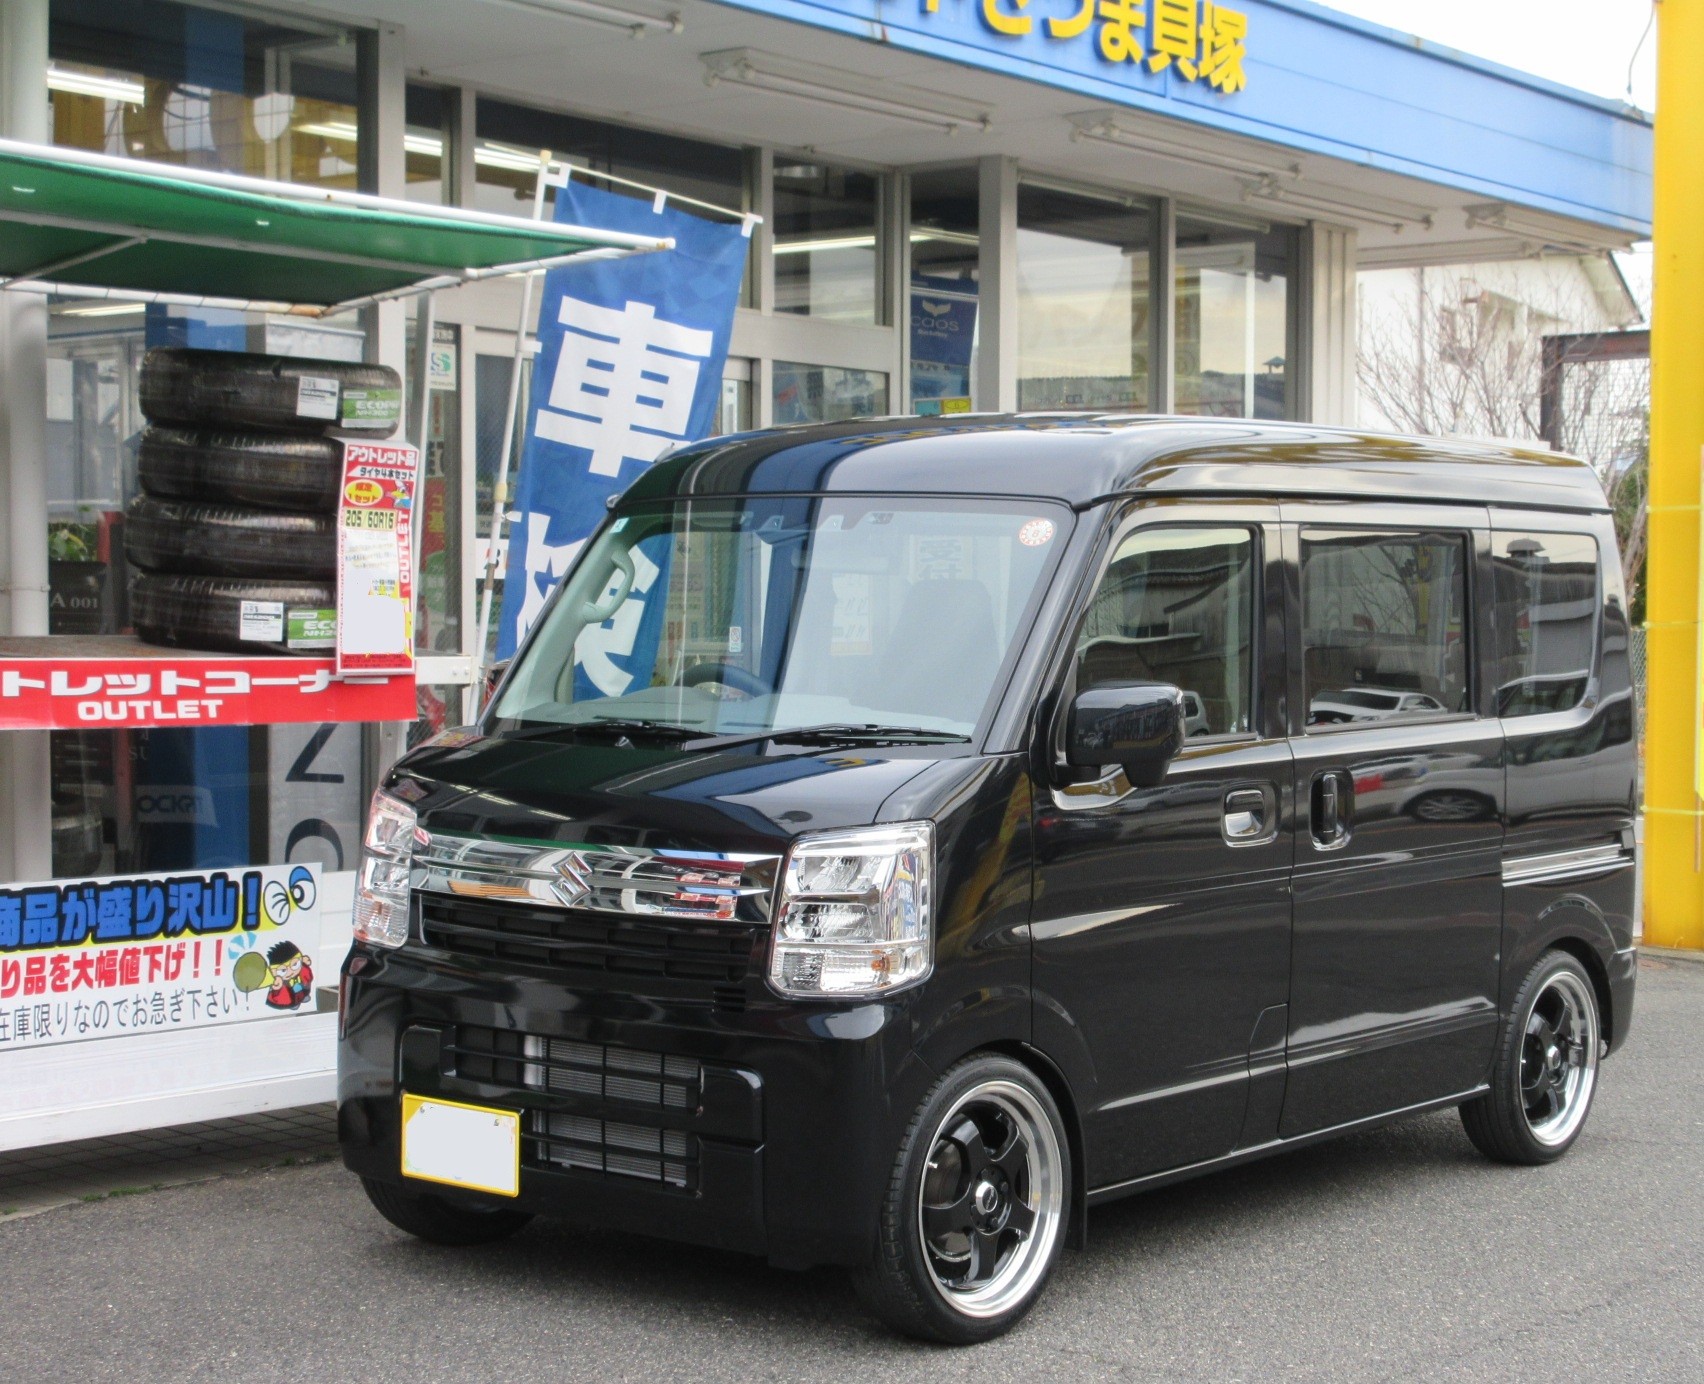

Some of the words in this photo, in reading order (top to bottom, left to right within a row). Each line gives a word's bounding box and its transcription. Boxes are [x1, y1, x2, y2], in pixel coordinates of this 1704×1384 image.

[348, 446, 416, 468] アウトレット品
[397, 511, 410, 584] OUTLET
[77, 700, 223, 721] OUTLET
